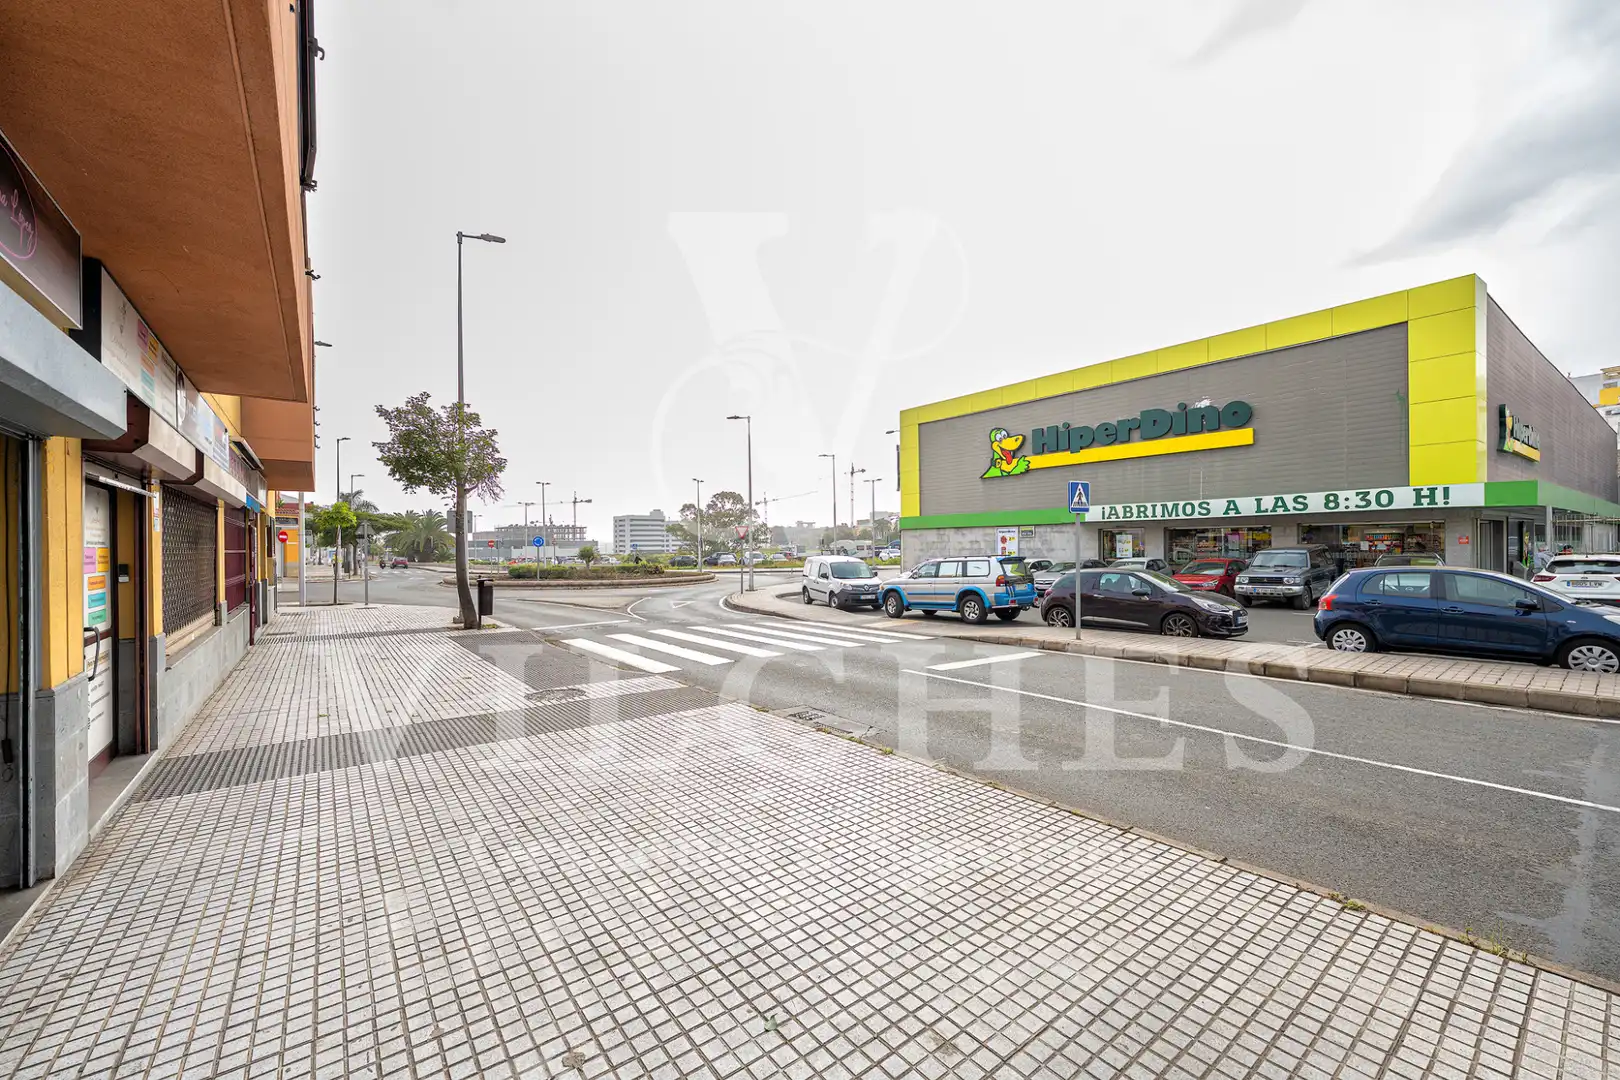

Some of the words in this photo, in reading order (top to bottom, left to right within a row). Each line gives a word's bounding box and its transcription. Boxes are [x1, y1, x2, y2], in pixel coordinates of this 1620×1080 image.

[1031, 400, 1253, 454] HiperDino
[1101, 501, 1211, 520] ¡ABRIMOS
[1223, 499, 1242, 516] A
[1255, 494, 1309, 514] LAS
[1324, 489, 1394, 511] 8:30
[1413, 486, 1450, 507] H!
